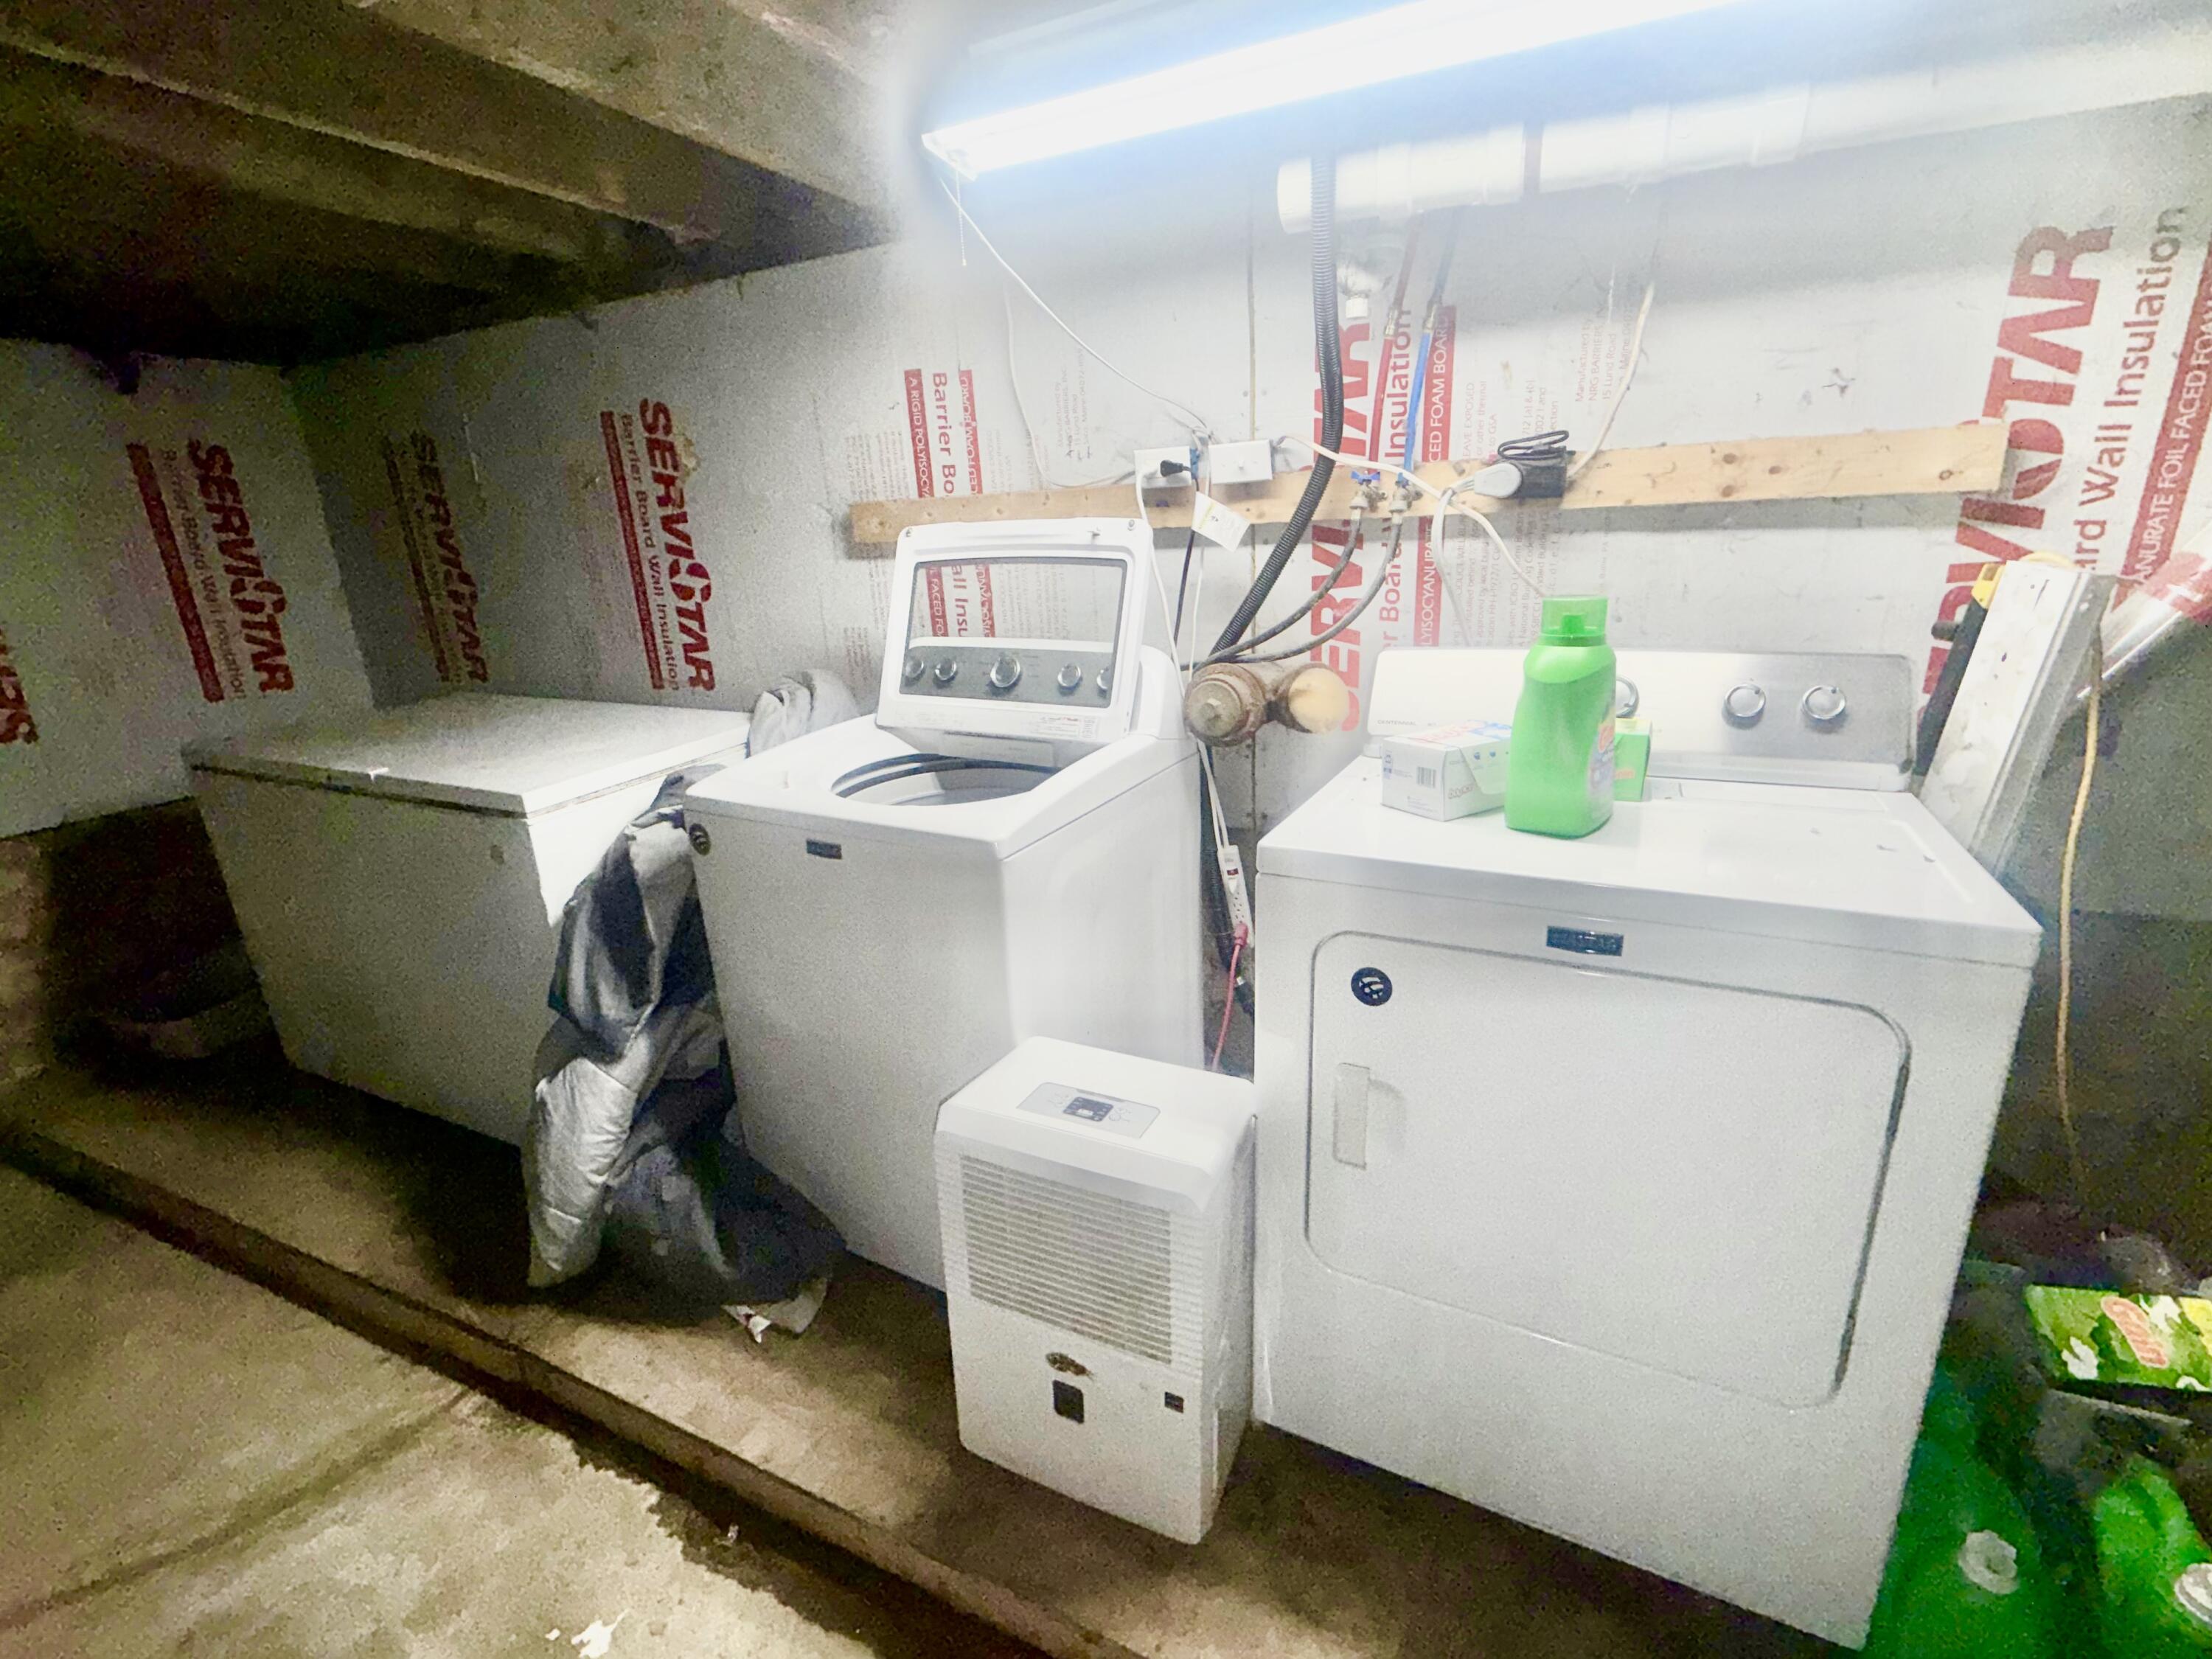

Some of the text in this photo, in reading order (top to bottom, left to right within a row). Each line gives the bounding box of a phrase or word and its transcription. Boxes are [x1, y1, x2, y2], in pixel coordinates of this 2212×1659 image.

[2104, 207, 2188, 407] Insulation
[1433, 313, 1449, 374] BOARD
[1573, 332, 1591, 402] Manufactured
[1605, 333, 1616, 359] Road
[908, 377, 918, 387] A
[1383, 310, 1412, 458] Insulation
[1588, 376, 1599, 400] NRG
[1603, 362, 1614, 387] Lund
[911, 390, 922, 425] RIGID
[933, 372, 952, 456] Barrier
[1430, 378, 1446, 427] FOAM
[1461, 382, 1475, 428] EXPOSED
[1548, 400, 1559, 431] ection
[2171, 369, 2208, 439] FACED
[959, 376, 977, 493] CED FOAM BOARD
[1428, 431, 1443, 462] CED
[1475, 419, 1485, 443] other
[2078, 423, 2132, 505] Wall
[2157, 442, 2190, 488] FOIL
[634, 489, 655, 549] Board
[639, 397, 716, 692] SERVISTAR
[1309, 320, 1371, 731] ERVITAR
[2135, 494, 2174, 584] ANURATE
[187, 439, 293, 692] SERVISTAR
[647, 554, 665, 596] Wall
[952, 565, 967, 589] all
[931, 578, 943, 615] FACED
[655, 602, 681, 692] Insulation
